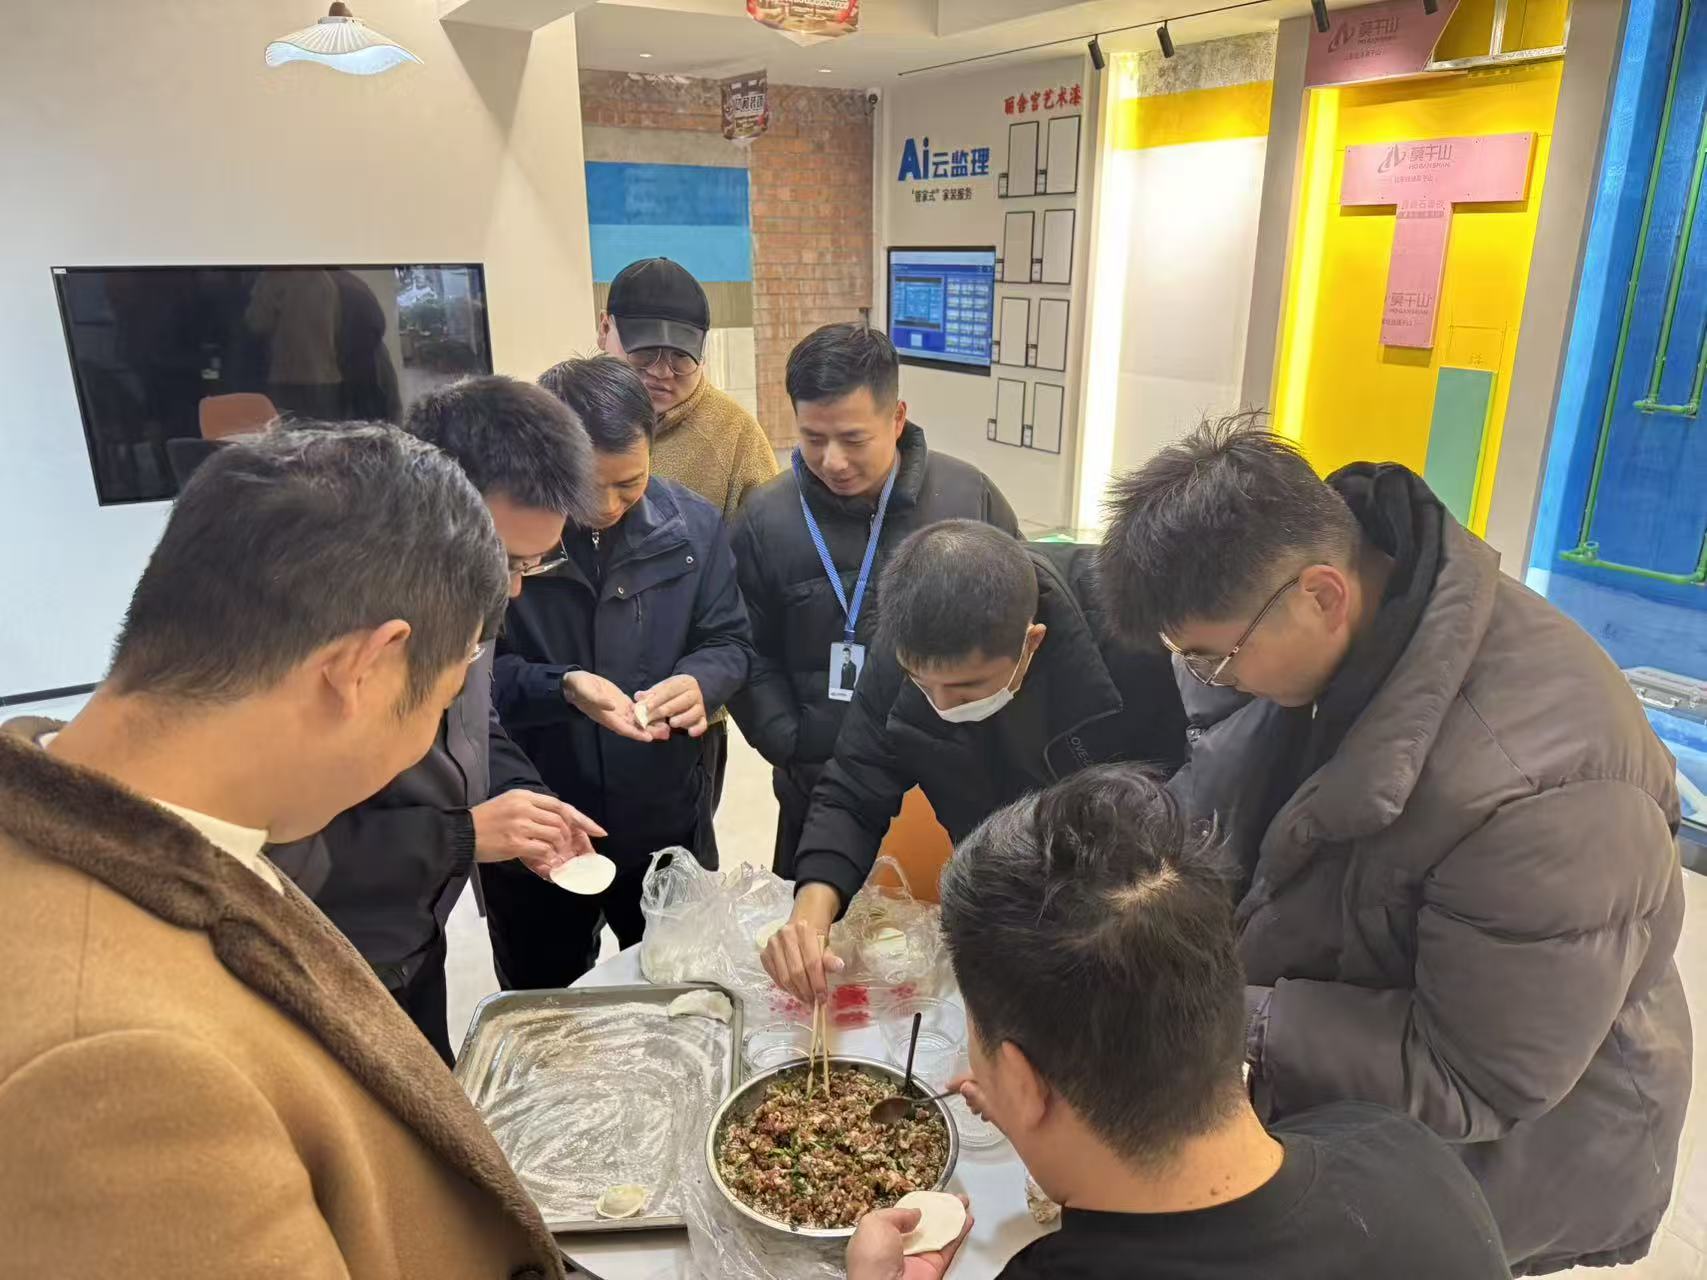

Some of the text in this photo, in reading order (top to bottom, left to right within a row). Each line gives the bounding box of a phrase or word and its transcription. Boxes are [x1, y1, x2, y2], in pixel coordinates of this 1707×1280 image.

[898, 136, 990, 181] Ai云监理
[1409, 143, 1453, 162] 莫干山
[1390, 290, 1431, 308] 莫干山
